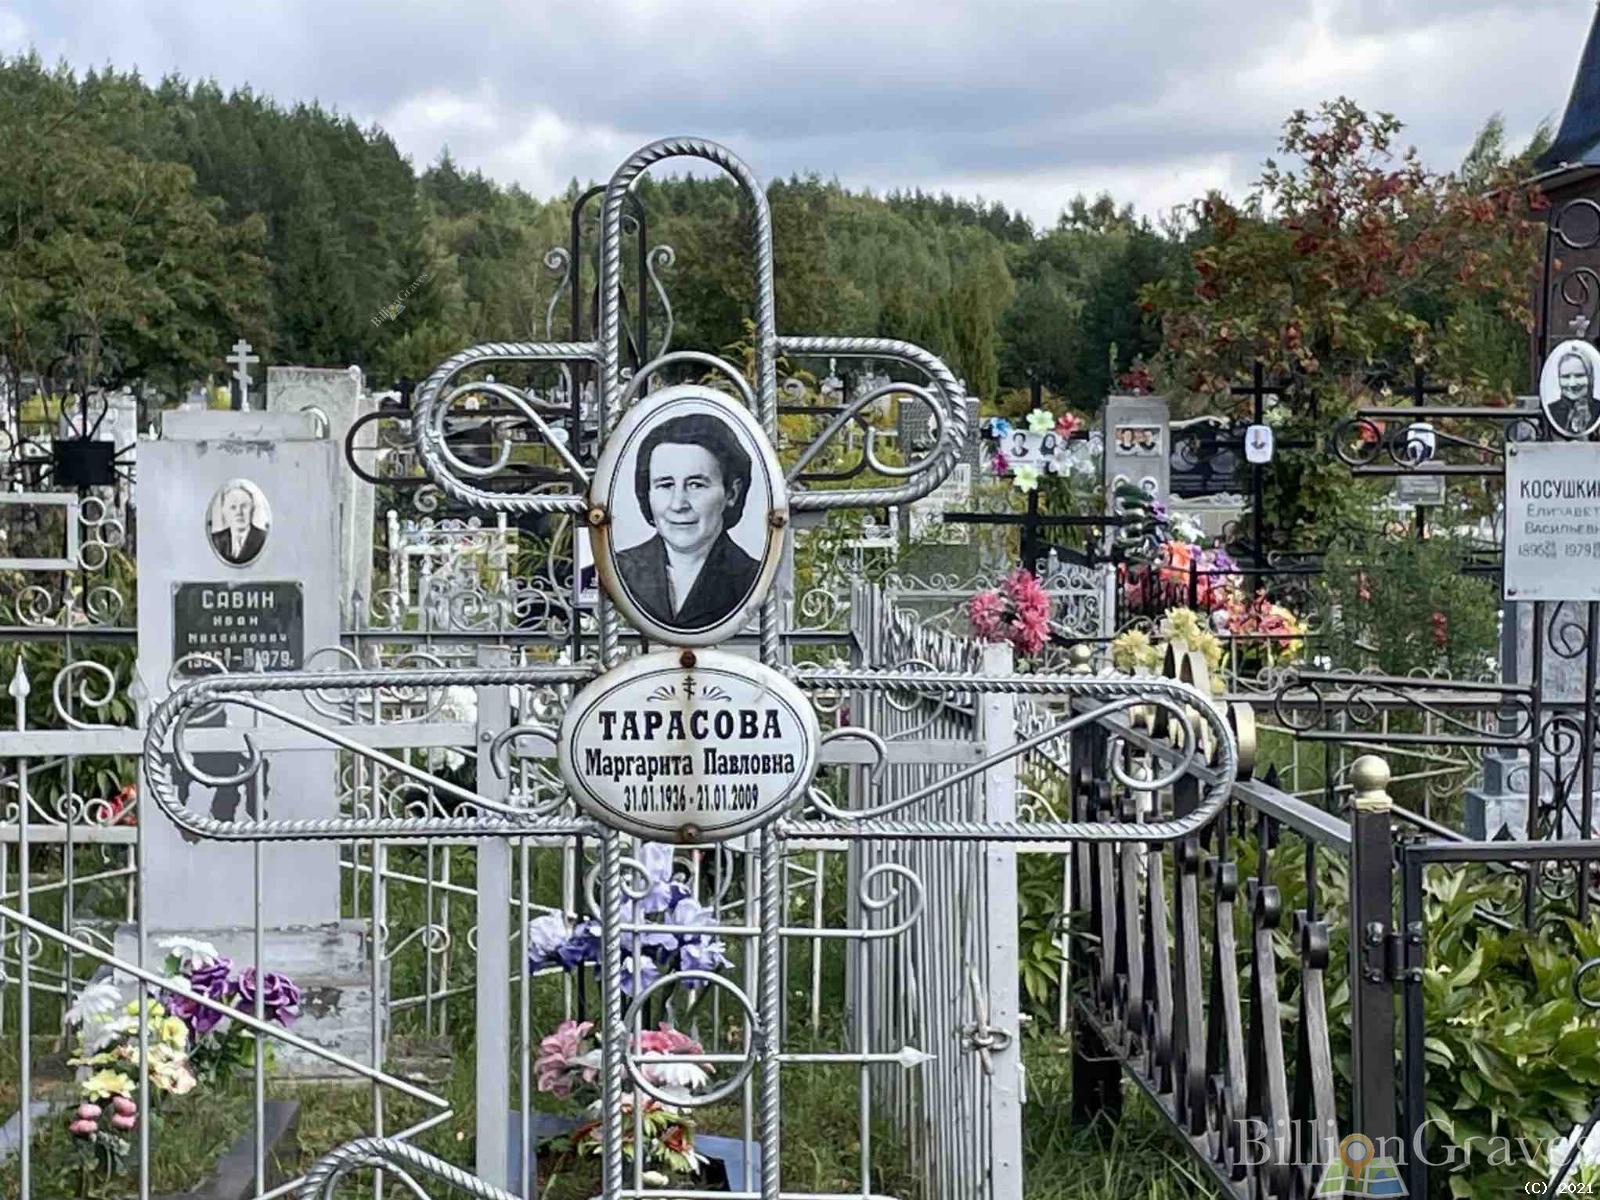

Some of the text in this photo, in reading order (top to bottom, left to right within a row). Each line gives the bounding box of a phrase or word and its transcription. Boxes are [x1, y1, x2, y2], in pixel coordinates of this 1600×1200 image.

[1520, 479, 1600, 499] КОСУШКИ
[202, 589, 274, 609] САВИН
[598, 708, 782, 741] ТАРАСОВА
[585, 747, 795, 782] Маргарита Павловна
[624, 785, 685, 812] 31.01.1936
[696, 784, 759, 811] 21.01.2009
